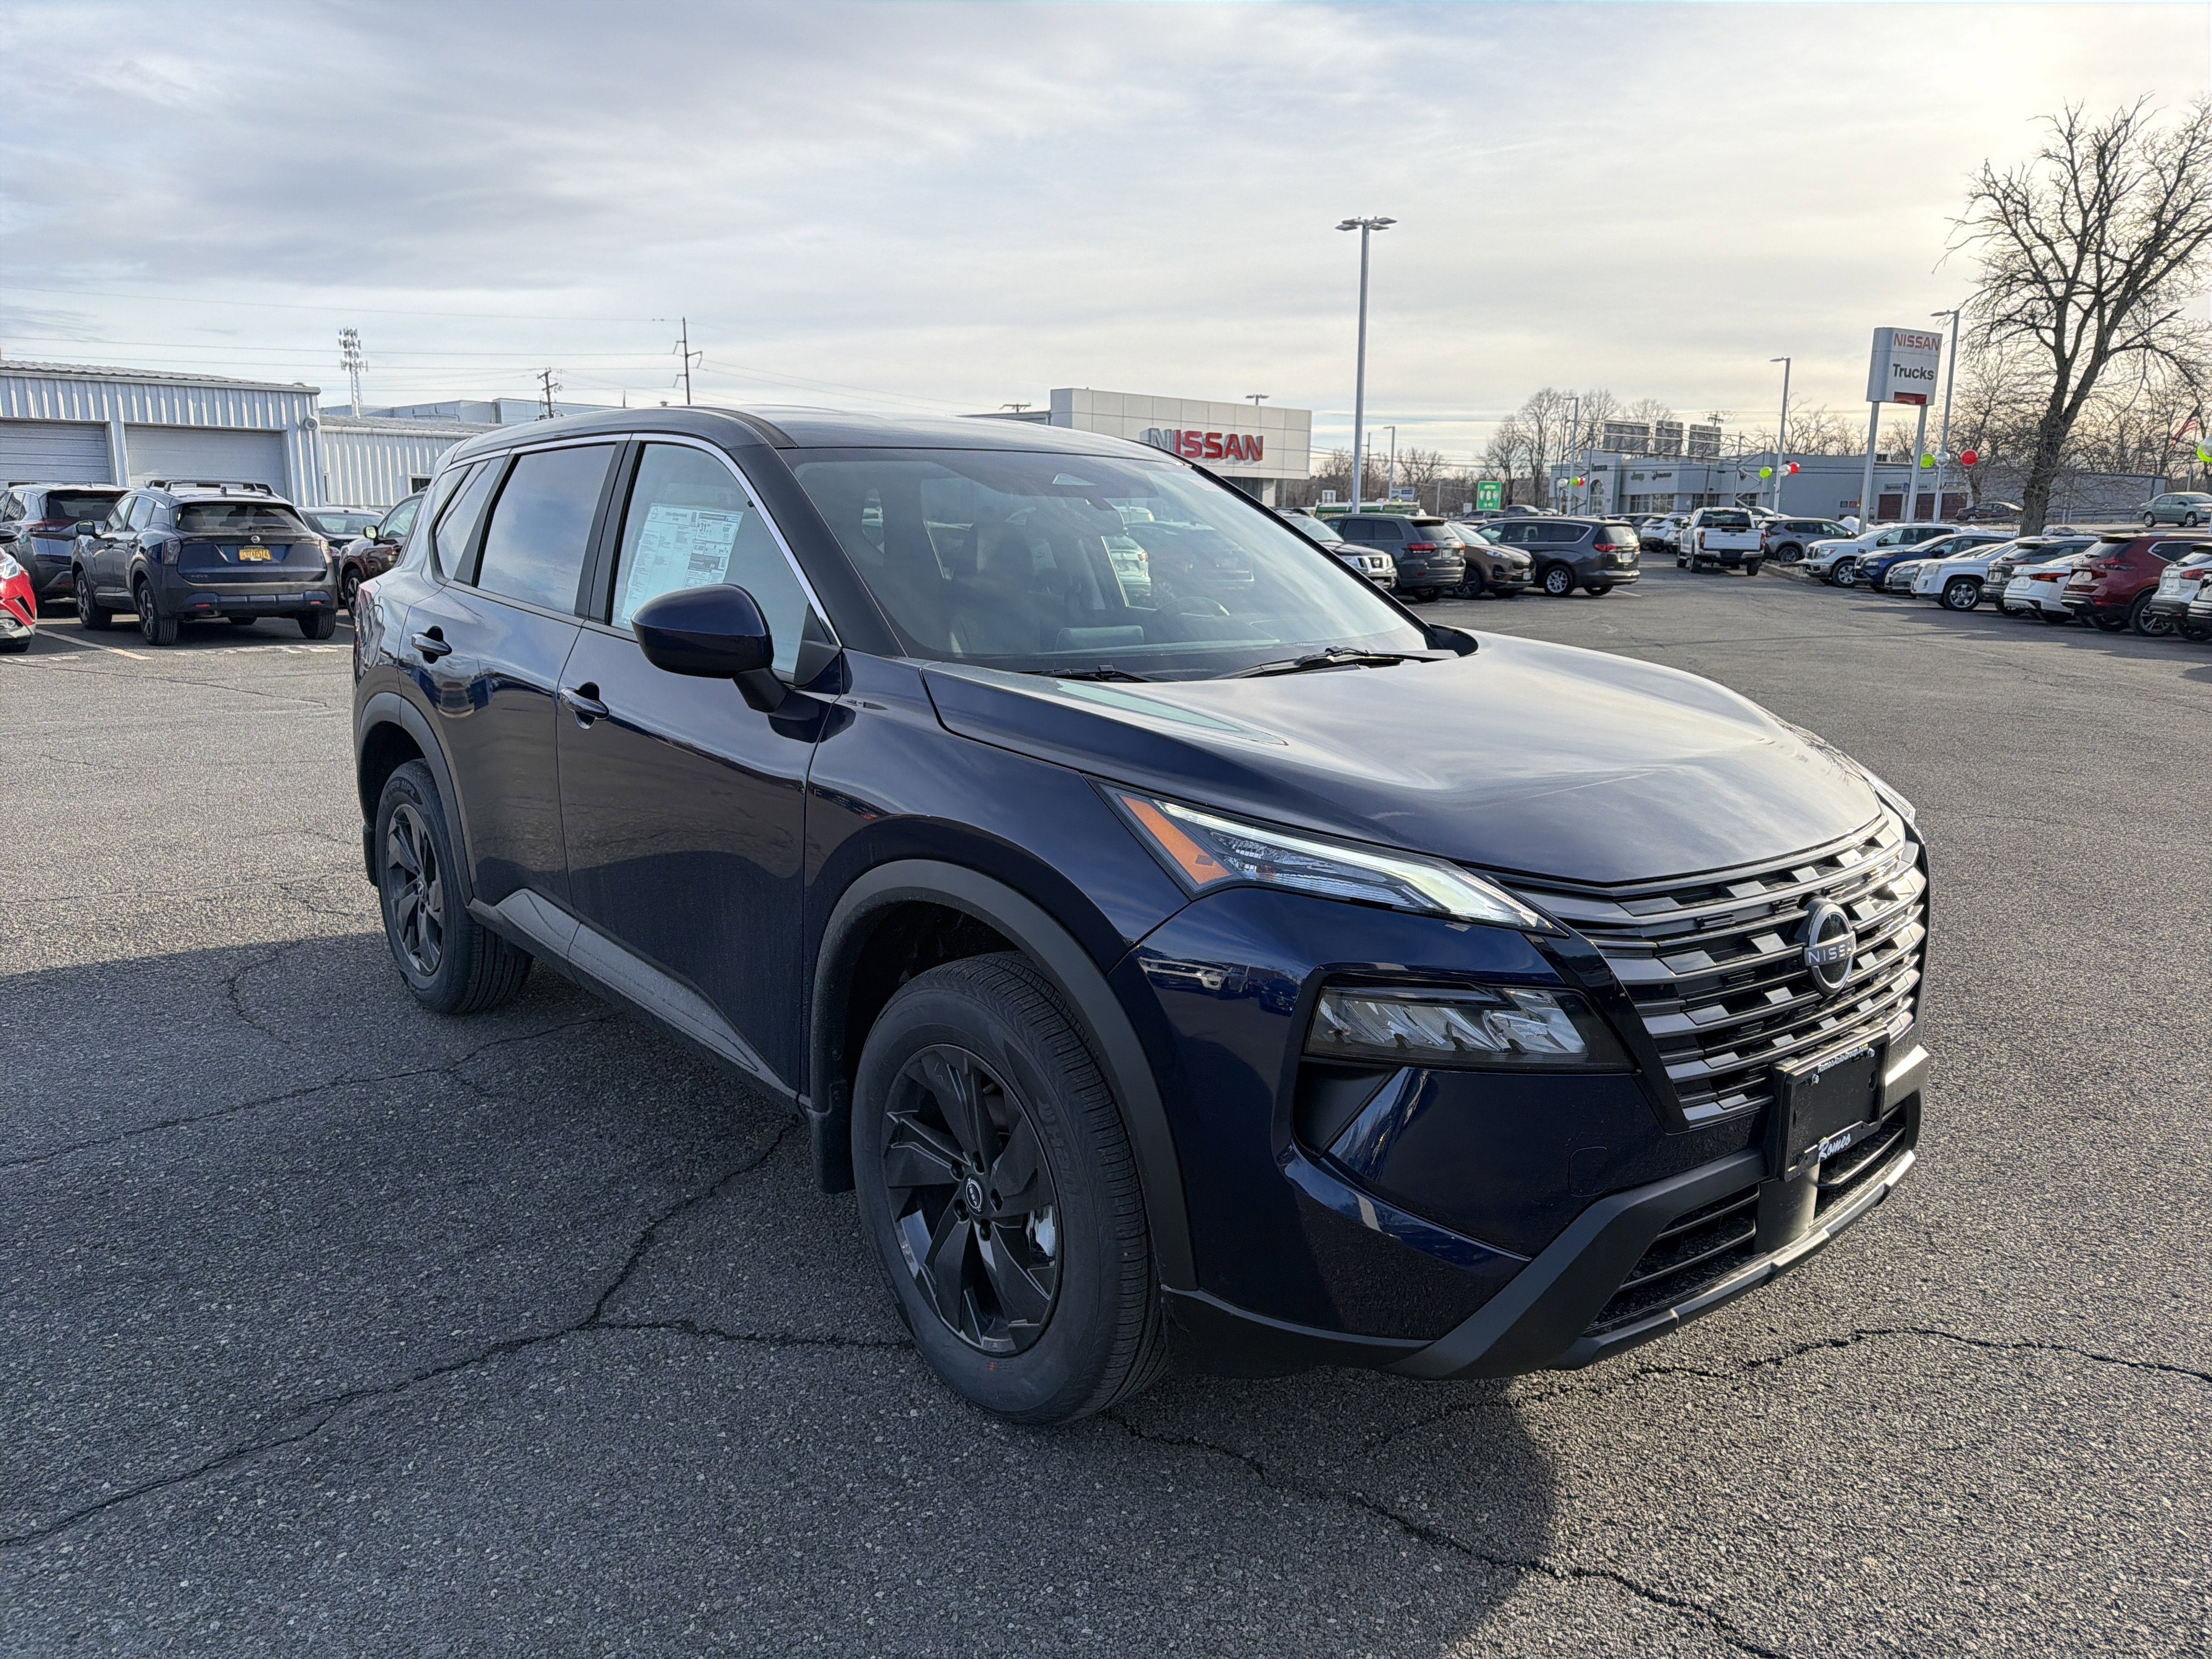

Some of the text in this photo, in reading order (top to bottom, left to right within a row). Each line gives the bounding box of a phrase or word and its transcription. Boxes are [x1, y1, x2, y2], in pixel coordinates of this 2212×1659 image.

[1894, 333, 1940, 351] NISSAN
[1893, 363, 1934, 380] Trucks
[1144, 427, 1263, 461] NISSAN
[1808, 942, 1853, 964] NISS
[1818, 1133, 1851, 1163] Romeo
